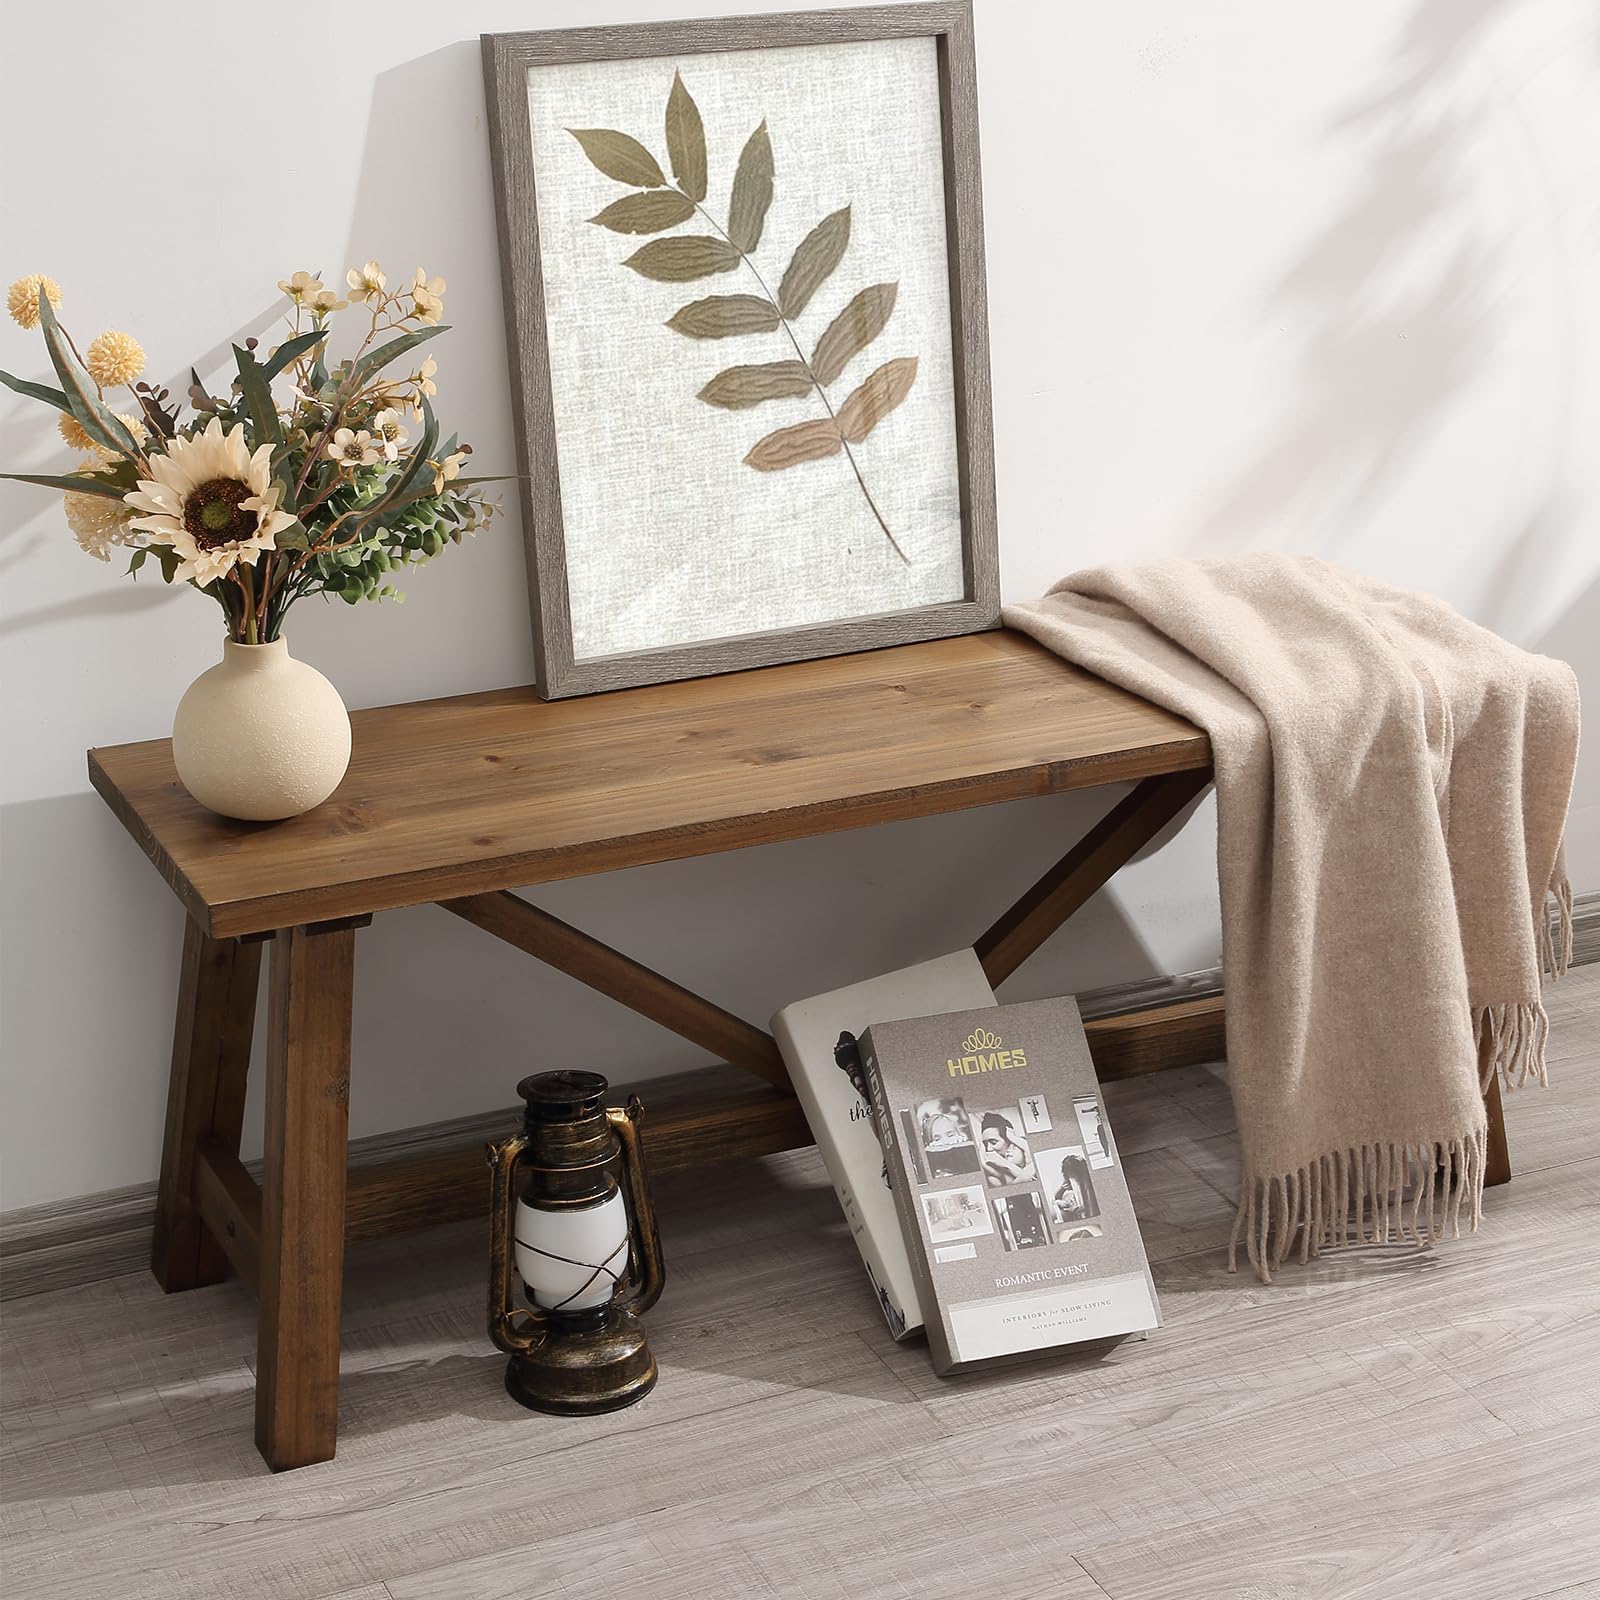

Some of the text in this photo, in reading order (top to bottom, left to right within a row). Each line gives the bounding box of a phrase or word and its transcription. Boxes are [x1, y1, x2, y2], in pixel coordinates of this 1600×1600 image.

[947, 1049, 1027, 1077] HOMES
[849, 1100, 873, 1122] the
[866, 1056, 893, 1149] HOMES
[995, 1263, 1089, 1288] ROMANTIC EVENT
[1002, 1299, 1112, 1324] INTERIORS for SLOW LIVING
